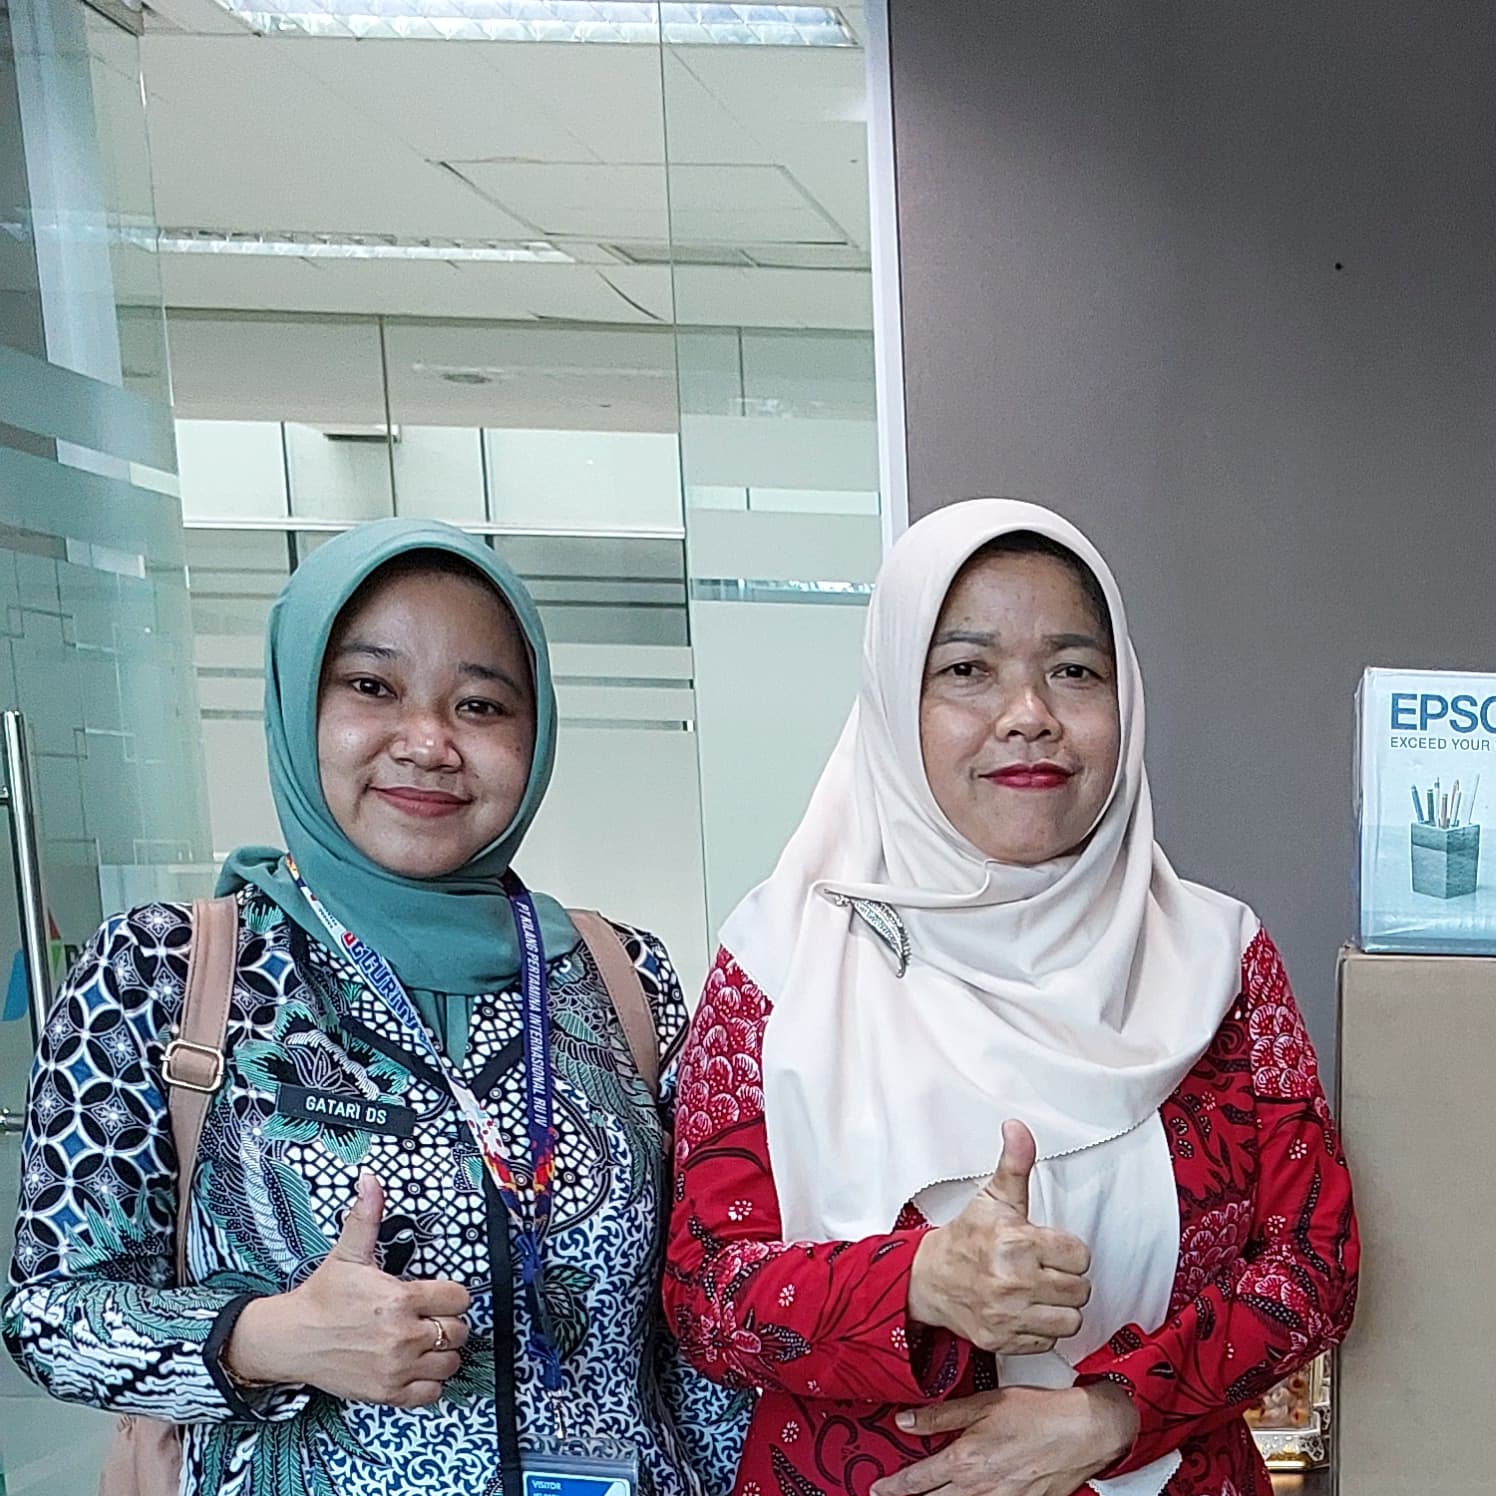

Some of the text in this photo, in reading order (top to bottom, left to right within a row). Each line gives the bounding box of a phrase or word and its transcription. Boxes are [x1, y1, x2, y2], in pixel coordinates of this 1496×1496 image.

[1390, 736, 1447, 749] EXCEED
[1451, 738, 1490, 751] YOUR
[520, 914, 539, 953] KILANG
[527, 951, 542, 1012] PERTAMINA
[528, 1011, 547, 1095] INTERNASIONAL
[305, 1096, 388, 1125] GATARI DS
[532, 1096, 548, 1114] RU
[534, 1113, 549, 1128] IV
